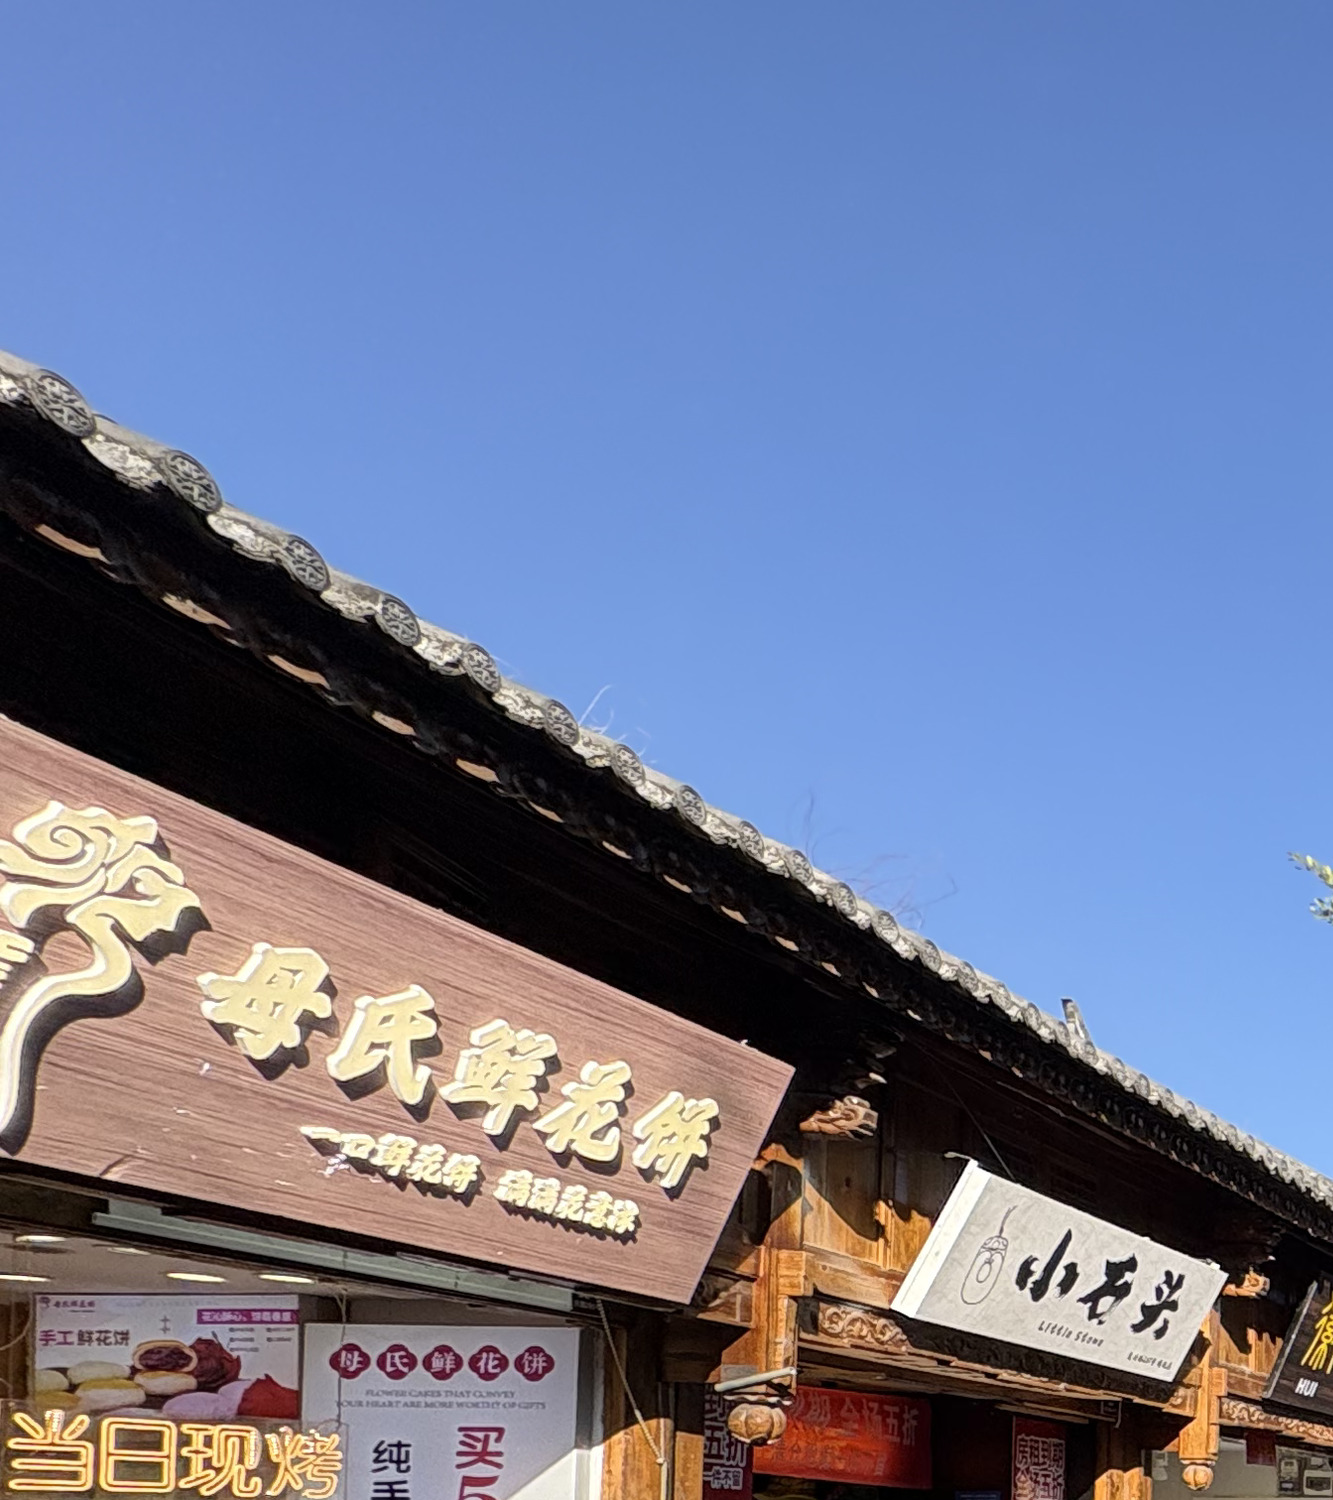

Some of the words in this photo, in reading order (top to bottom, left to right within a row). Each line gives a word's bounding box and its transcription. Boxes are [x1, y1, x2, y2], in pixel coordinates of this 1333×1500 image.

[198, 942, 719, 1187] 母氏鲜花饼
[1015, 1228, 1185, 1340] 小石头
[338, 1350, 549, 1376] 母氏鲜花饼
[1294, 1378, 1318, 1397] HUI
[7, 1408, 346, 1499] 当日现烤
